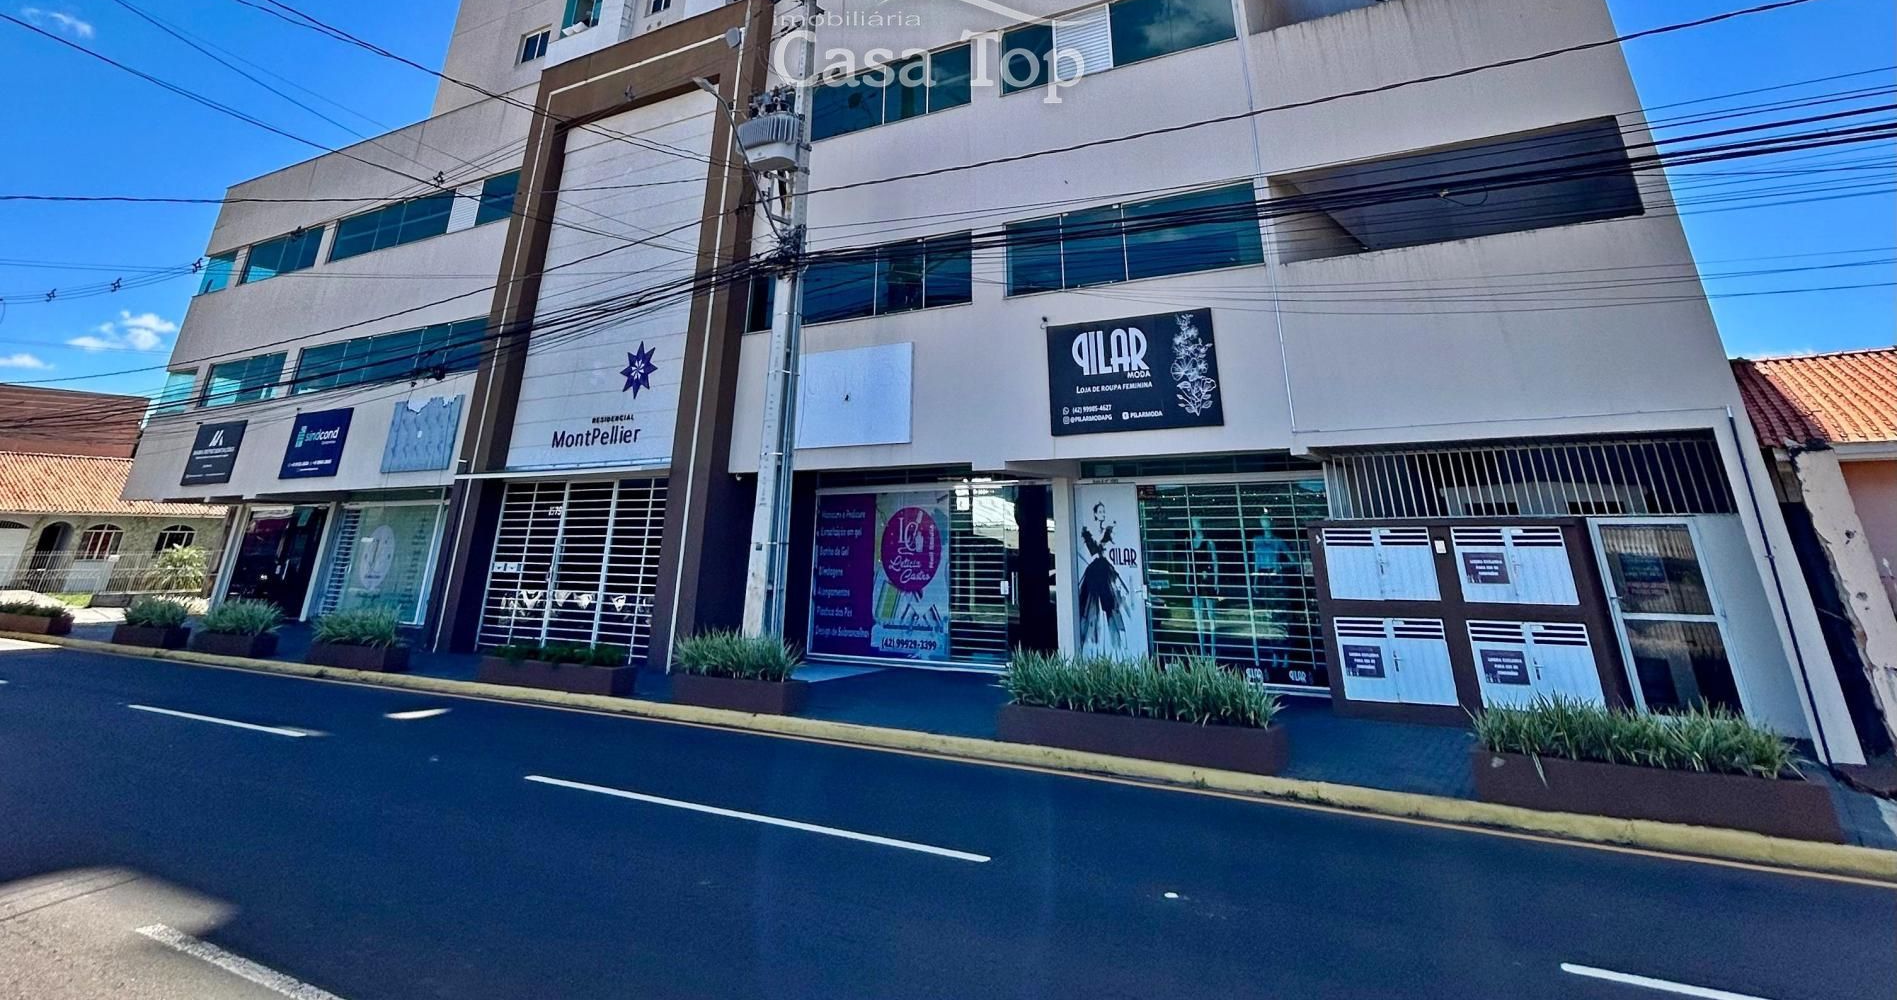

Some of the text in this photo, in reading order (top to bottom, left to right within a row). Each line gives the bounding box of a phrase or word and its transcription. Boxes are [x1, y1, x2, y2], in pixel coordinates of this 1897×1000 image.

[1072, 327, 1150, 376] PILAR
[1127, 371, 1151, 379] MODA
[1101, 384, 1122, 392] ROUPA
[1122, 381, 1153, 390] FEMININA
[592, 414, 634, 424] RESIDENCIAL
[1130, 410, 1163, 418] PILARMODA
[552, 425, 641, 448] MontPellier
[1109, 548, 1138, 566] PILAR
[882, 637, 895, 649] (42)
